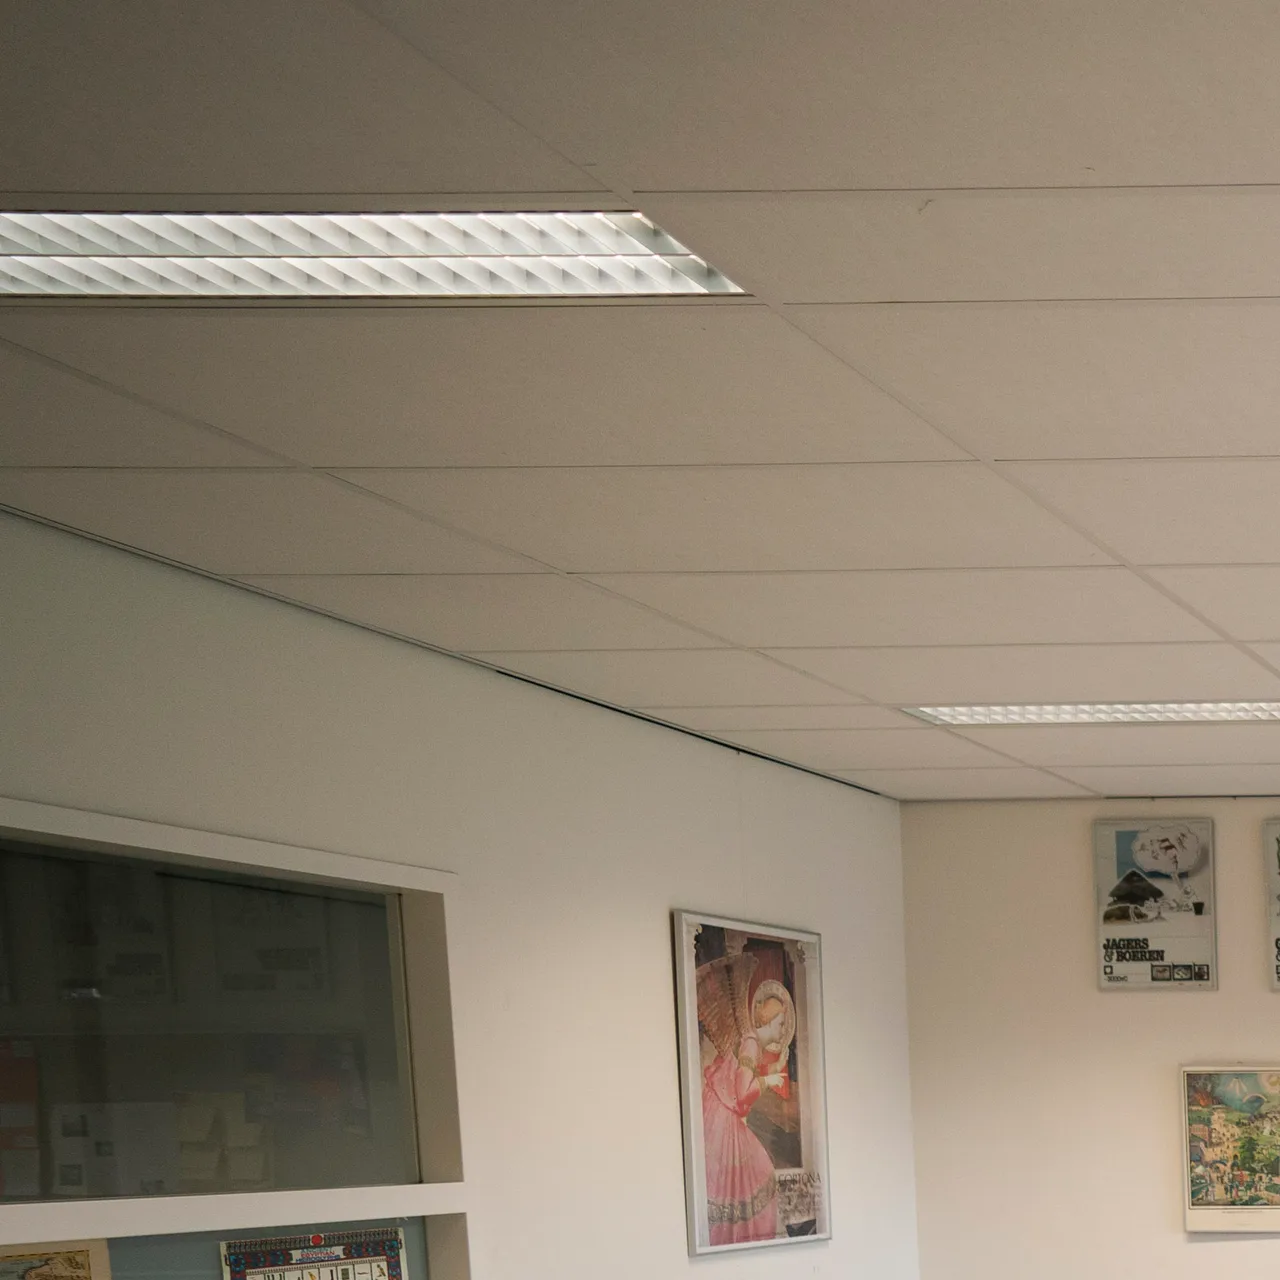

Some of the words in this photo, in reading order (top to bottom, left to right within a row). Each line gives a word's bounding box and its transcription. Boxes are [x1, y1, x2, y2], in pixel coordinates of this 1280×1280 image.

[1103, 937, 1149, 950] JAGERS
[1104, 950, 1114, 962] &
[1116, 950, 1165, 961] BOEREN
